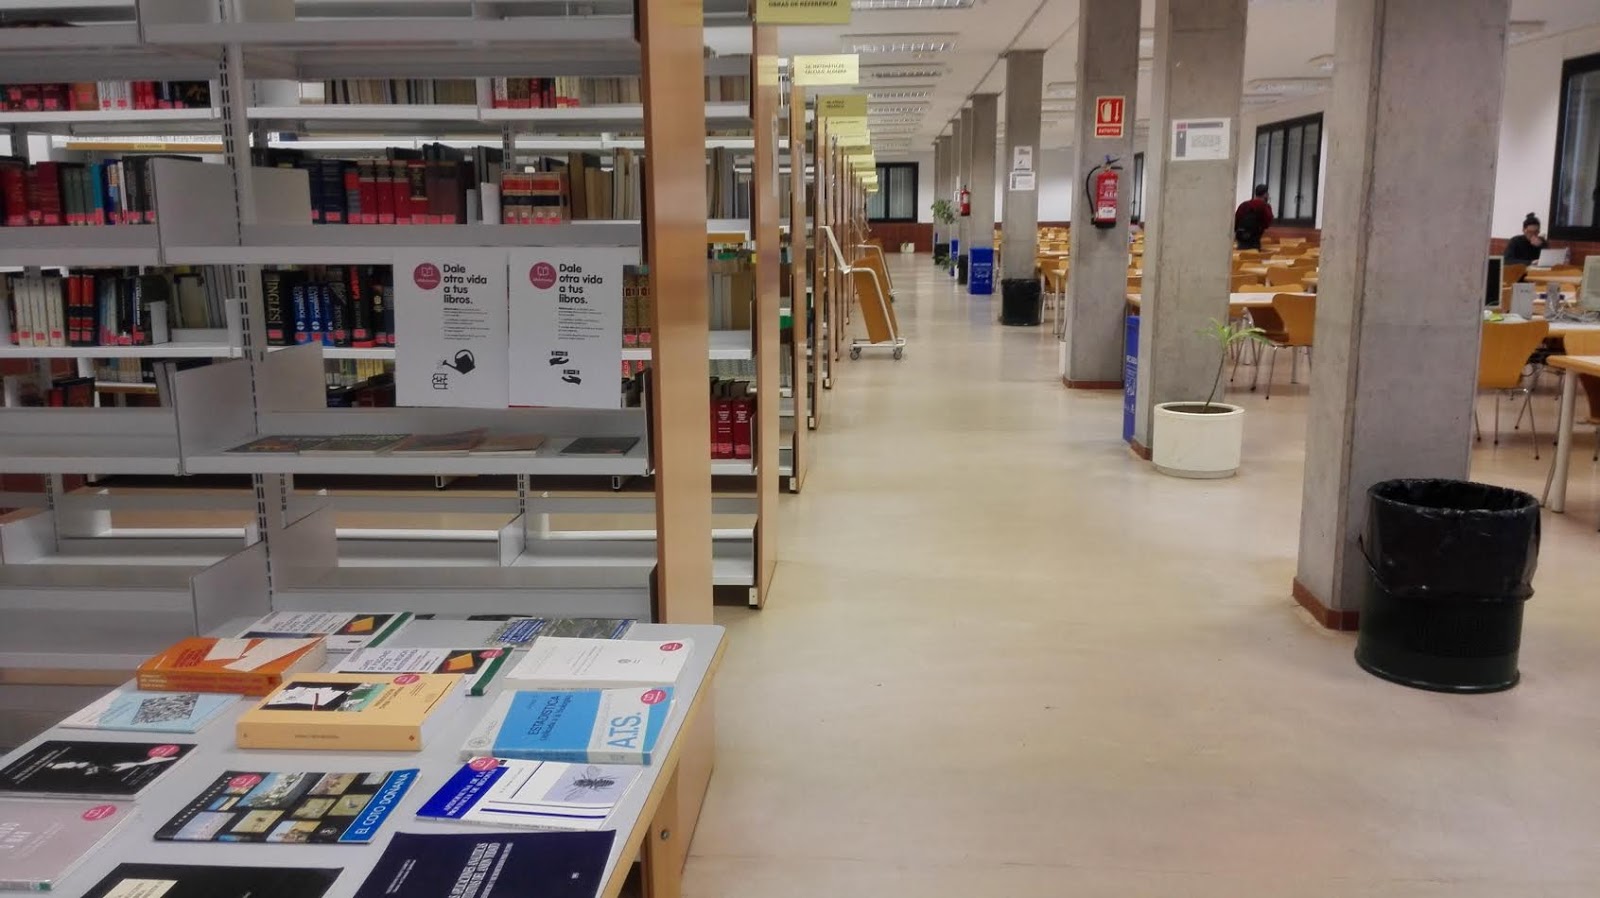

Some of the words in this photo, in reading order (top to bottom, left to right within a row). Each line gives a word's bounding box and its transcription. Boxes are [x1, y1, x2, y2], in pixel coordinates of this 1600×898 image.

[444, 264, 466, 273] Dale
[559, 264, 582, 273] Dale
[444, 275, 464, 283] otra
[466, 274, 487, 284] vida
[559, 275, 579, 283] otra
[582, 274, 603, 284] vida
[453, 285, 468, 294] tus
[569, 284, 583, 293] tus
[444, 294, 473, 304] libros.
[559, 294, 588, 304] libros.
[354, 826, 370, 835] EL
[362, 805, 387, 826] COTO
[379, 772, 411, 805] DOÑANA
